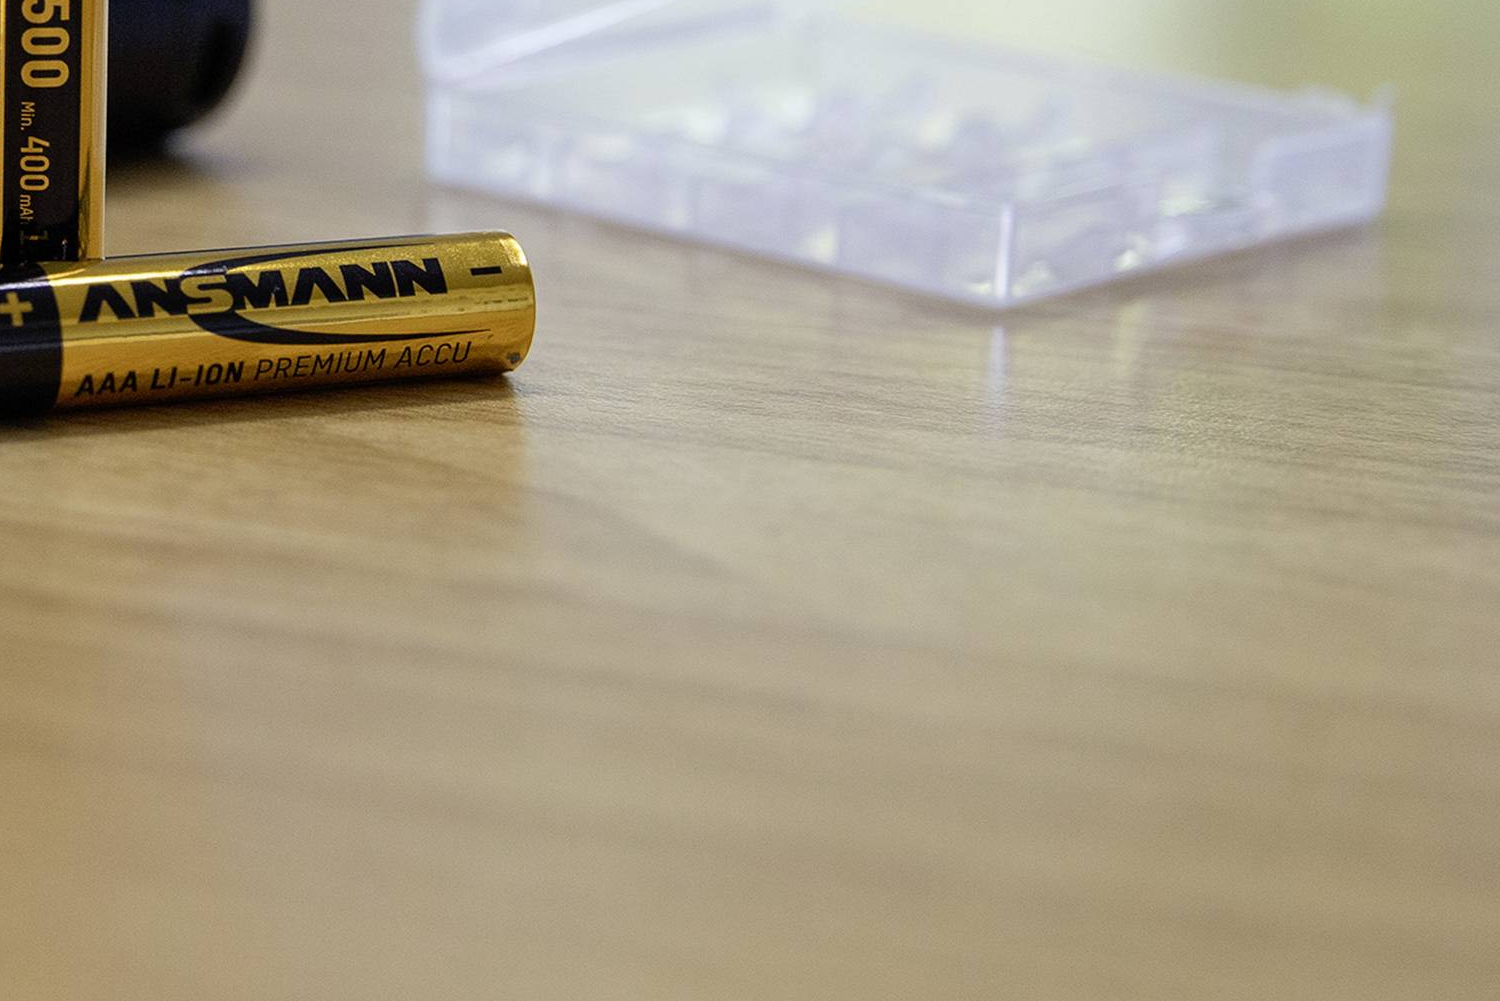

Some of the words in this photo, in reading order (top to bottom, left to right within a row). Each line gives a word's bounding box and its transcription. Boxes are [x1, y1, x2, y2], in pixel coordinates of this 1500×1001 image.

[19, 101, 36, 131] Min.
[19, 135, 50, 192] 400
[77, 256, 448, 323] ANSMANN
[75, 370, 139, 398] AAA
[149, 360, 245, 393] LI-ION
[253, 349, 388, 382] PREMIUM
[394, 340, 474, 370] ACCU
